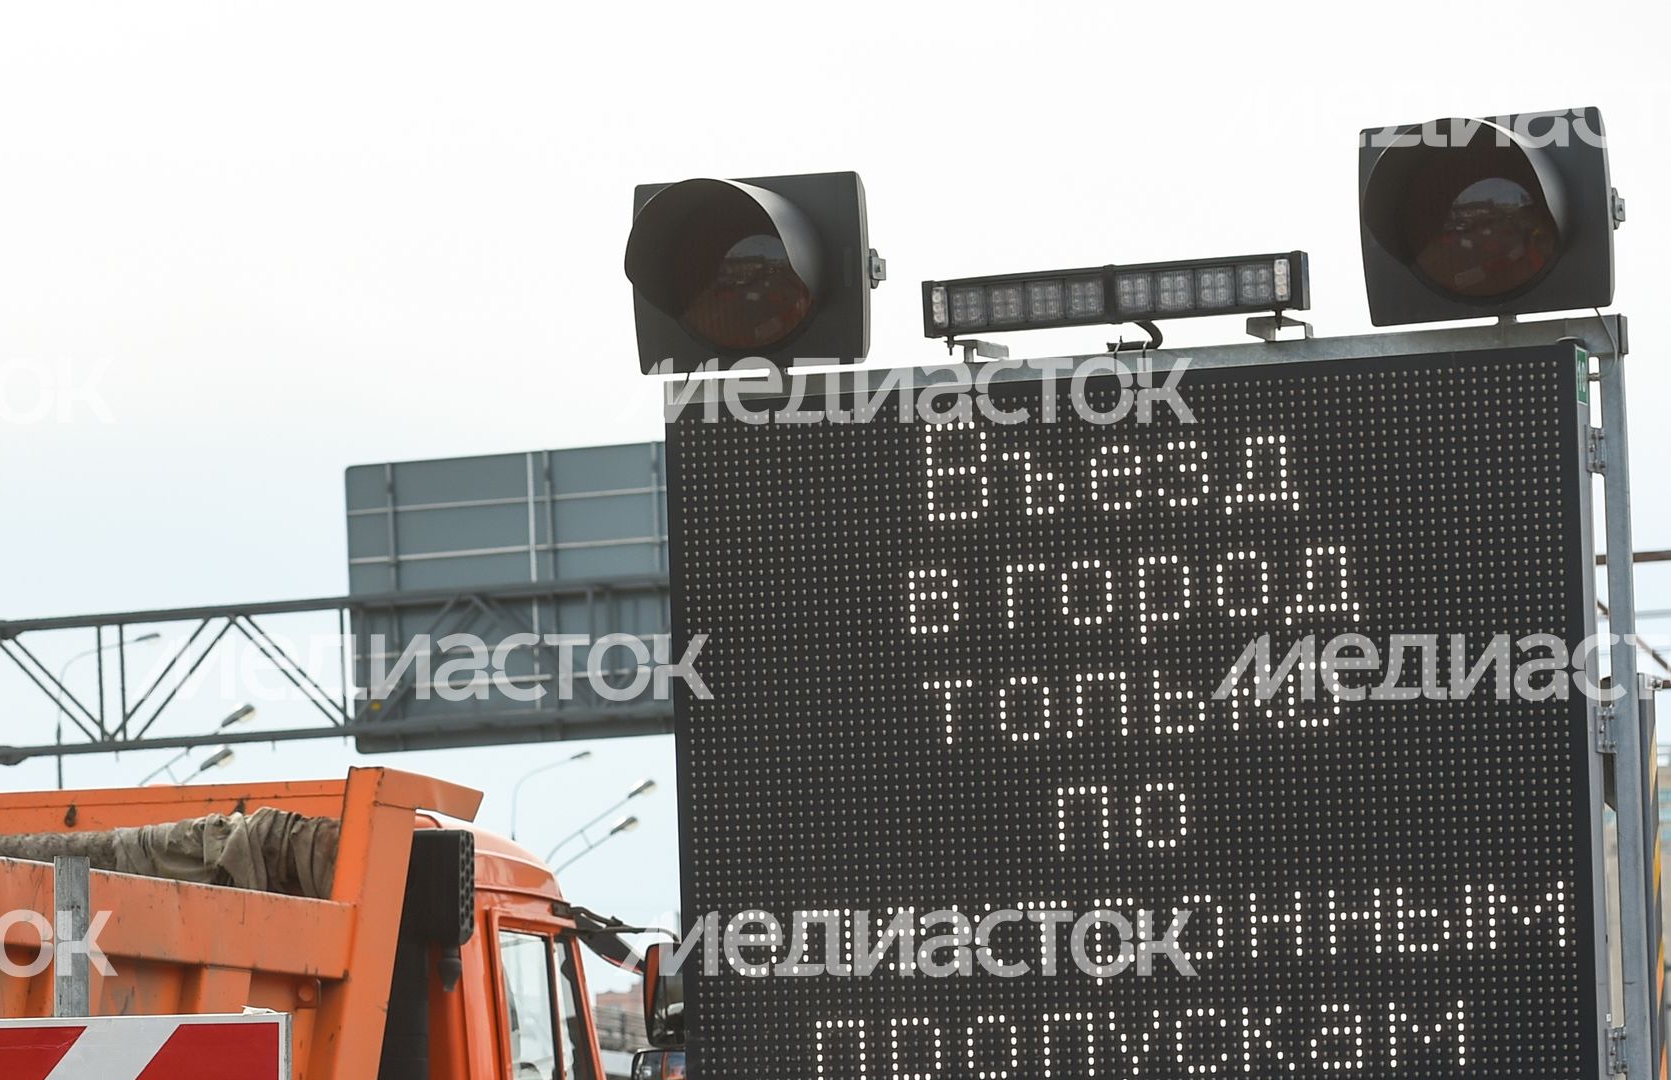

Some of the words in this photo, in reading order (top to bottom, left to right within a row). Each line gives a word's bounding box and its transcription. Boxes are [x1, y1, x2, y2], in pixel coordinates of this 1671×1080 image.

[925, 420, 1299, 520] Въезд
[908, 569, 960, 635] в
[1005, 546, 1360, 645] город
[921, 661, 1340, 745] только
[1056, 781, 1188, 852] по
[727, 880, 1566, 985] электронным
